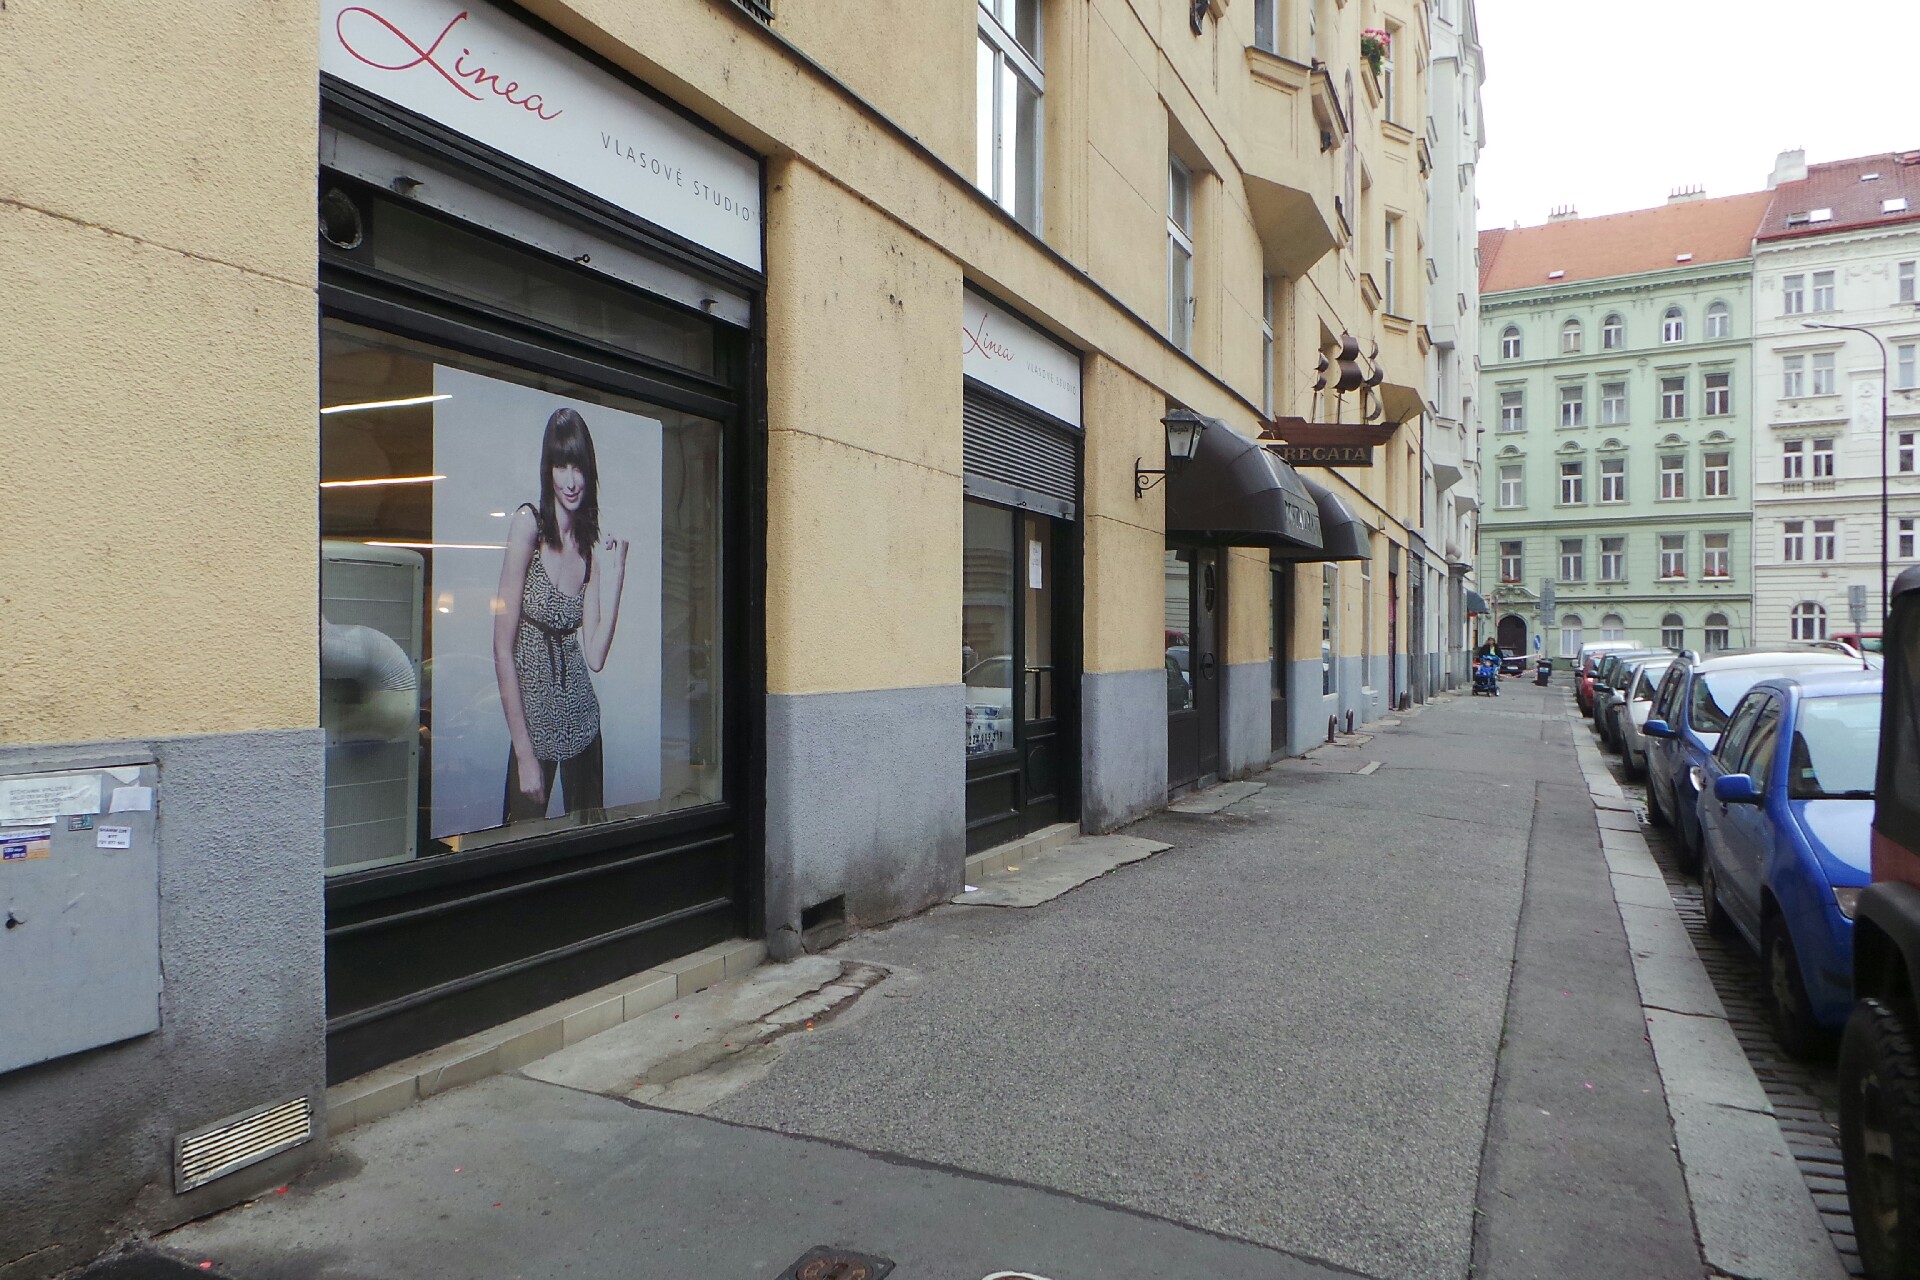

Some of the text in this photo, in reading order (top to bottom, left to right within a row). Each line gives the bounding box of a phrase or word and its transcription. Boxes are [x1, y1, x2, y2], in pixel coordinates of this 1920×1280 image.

[336, 6, 563, 121] Linea
[600, 131, 751, 222] VLASOVÉ STUDIO
[963, 313, 1014, 362] Linea
[1056, 377, 1077, 396] STUDIO
